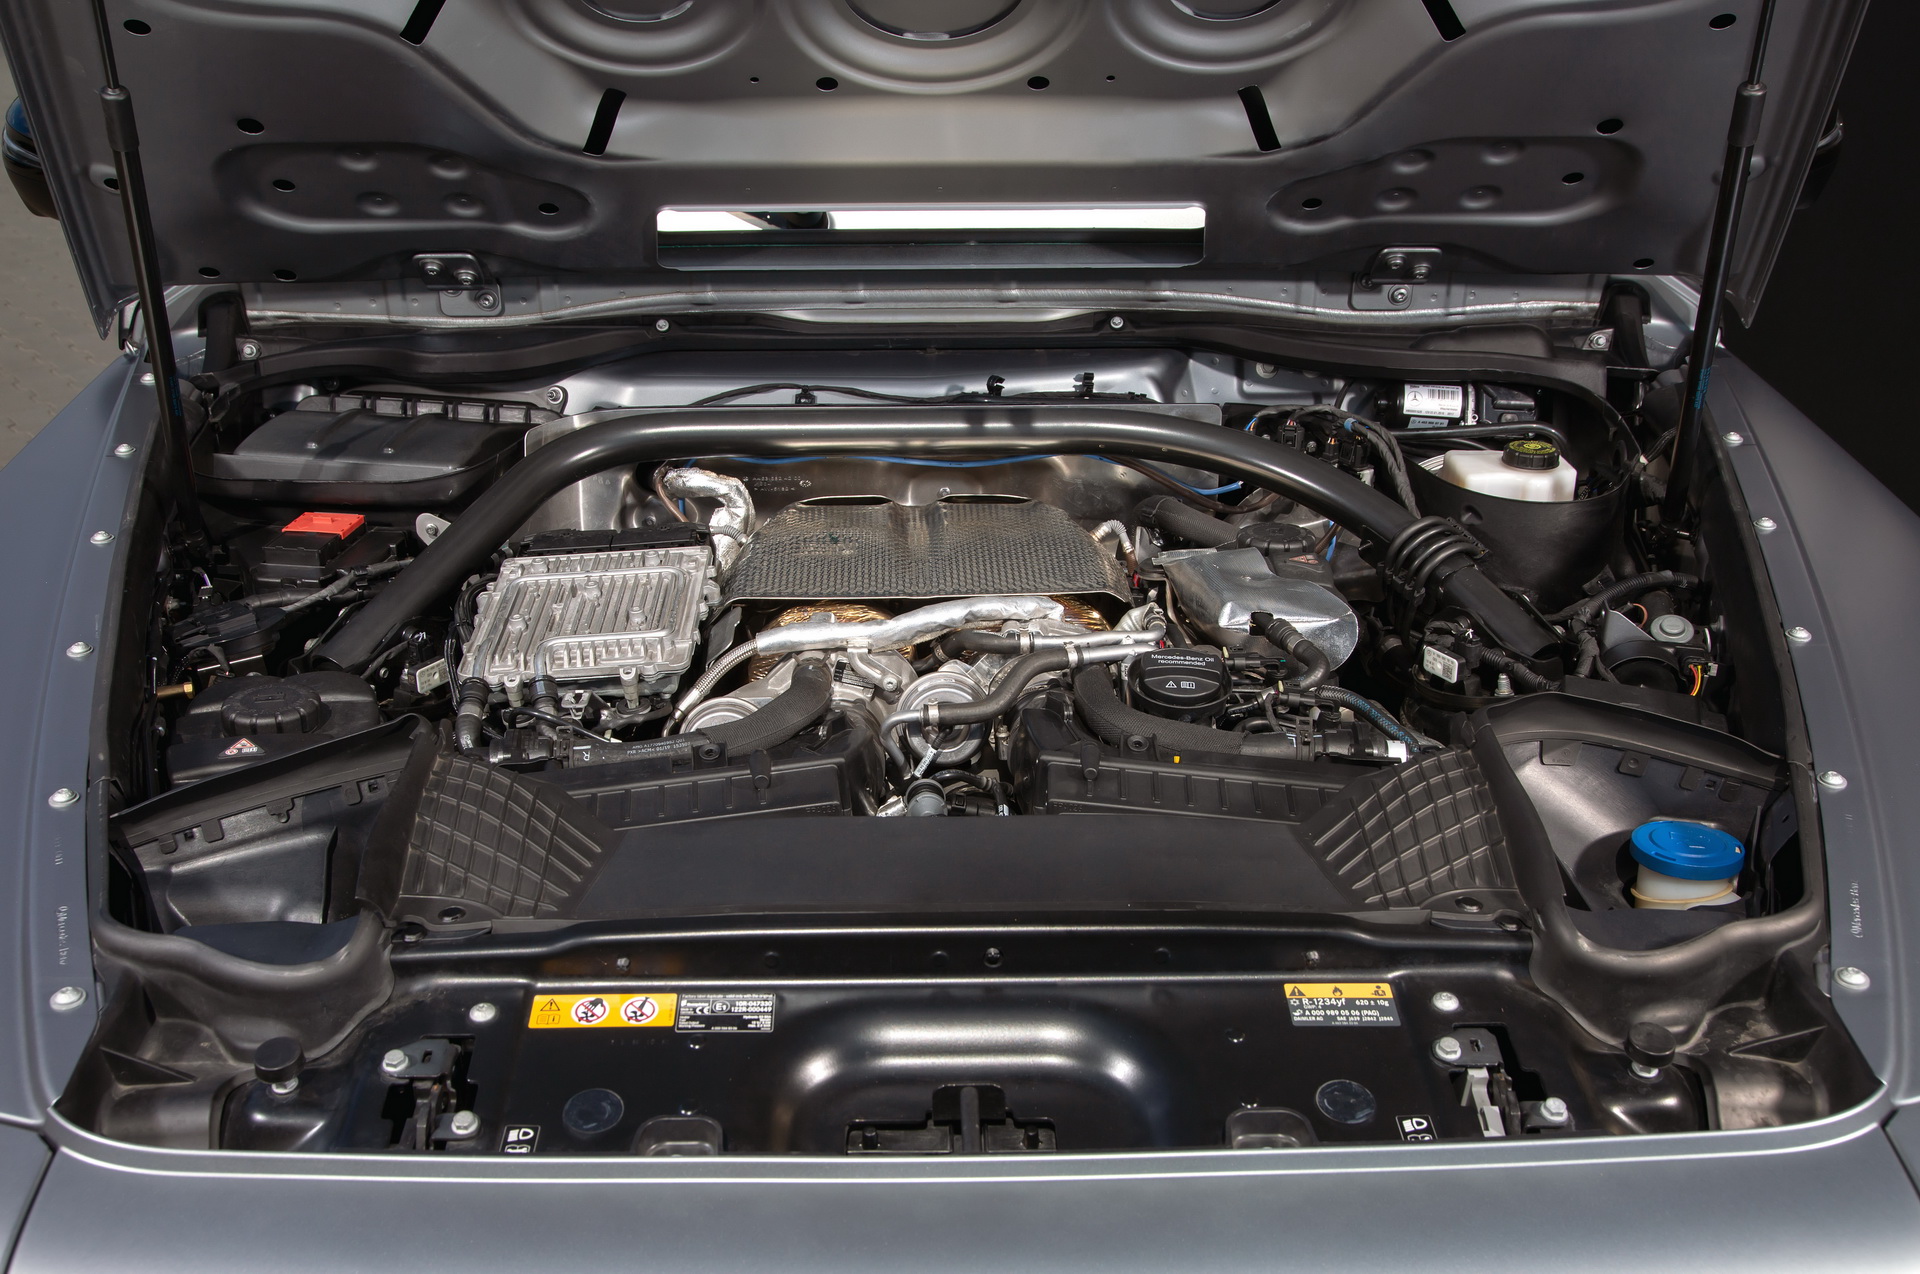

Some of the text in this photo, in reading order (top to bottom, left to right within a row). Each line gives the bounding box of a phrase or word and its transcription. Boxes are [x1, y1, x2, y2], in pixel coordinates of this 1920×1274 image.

[582, 750, 591, 761] R
[1302, 997, 1346, 1007] R-1234yf
[1377, 999, 1390, 1007] 10g
[1361, 1009, 1380, 1017] (PAG)
